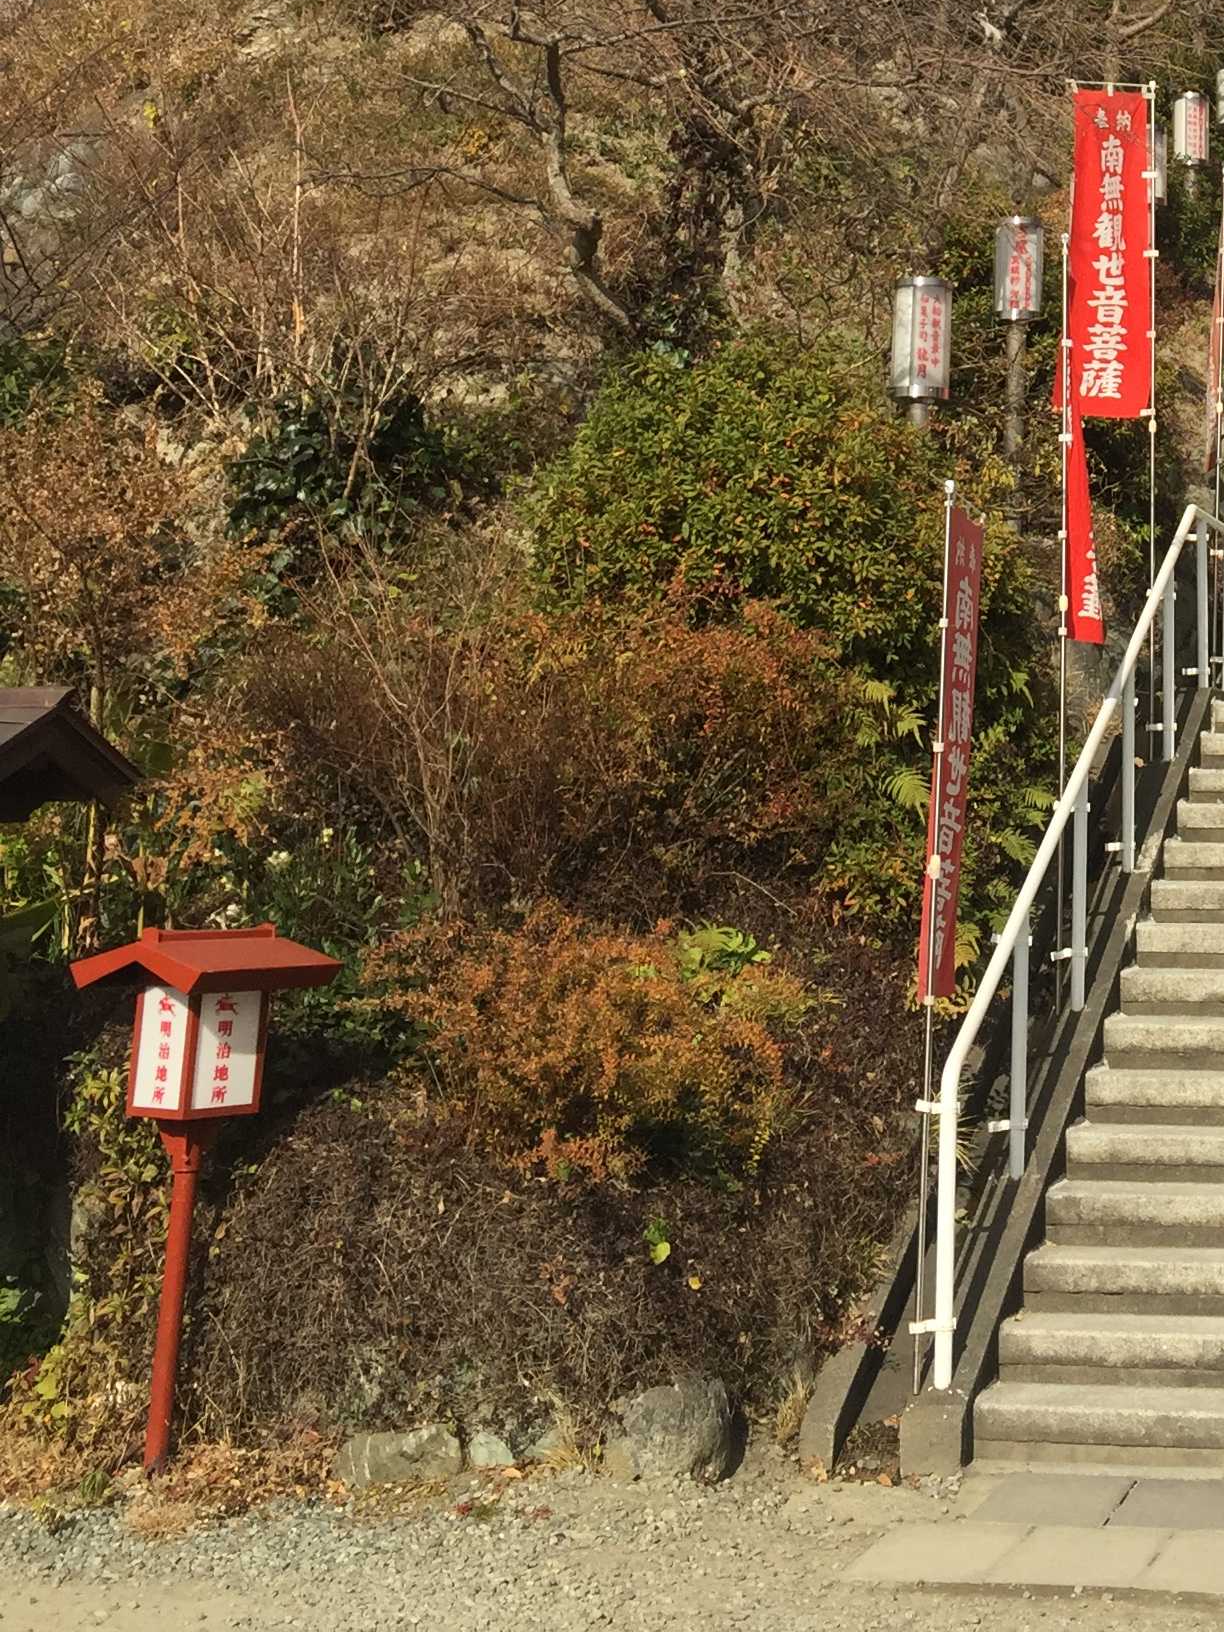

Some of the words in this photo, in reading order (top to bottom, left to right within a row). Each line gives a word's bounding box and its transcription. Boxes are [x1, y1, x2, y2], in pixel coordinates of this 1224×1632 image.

[1094, 107, 1132, 133] 奉納
[1080, 134, 1129, 399] 南無観世音菩薩
[152, 1020, 172, 1104] 明治地所
[210, 1020, 233, 1103] 明治地所
